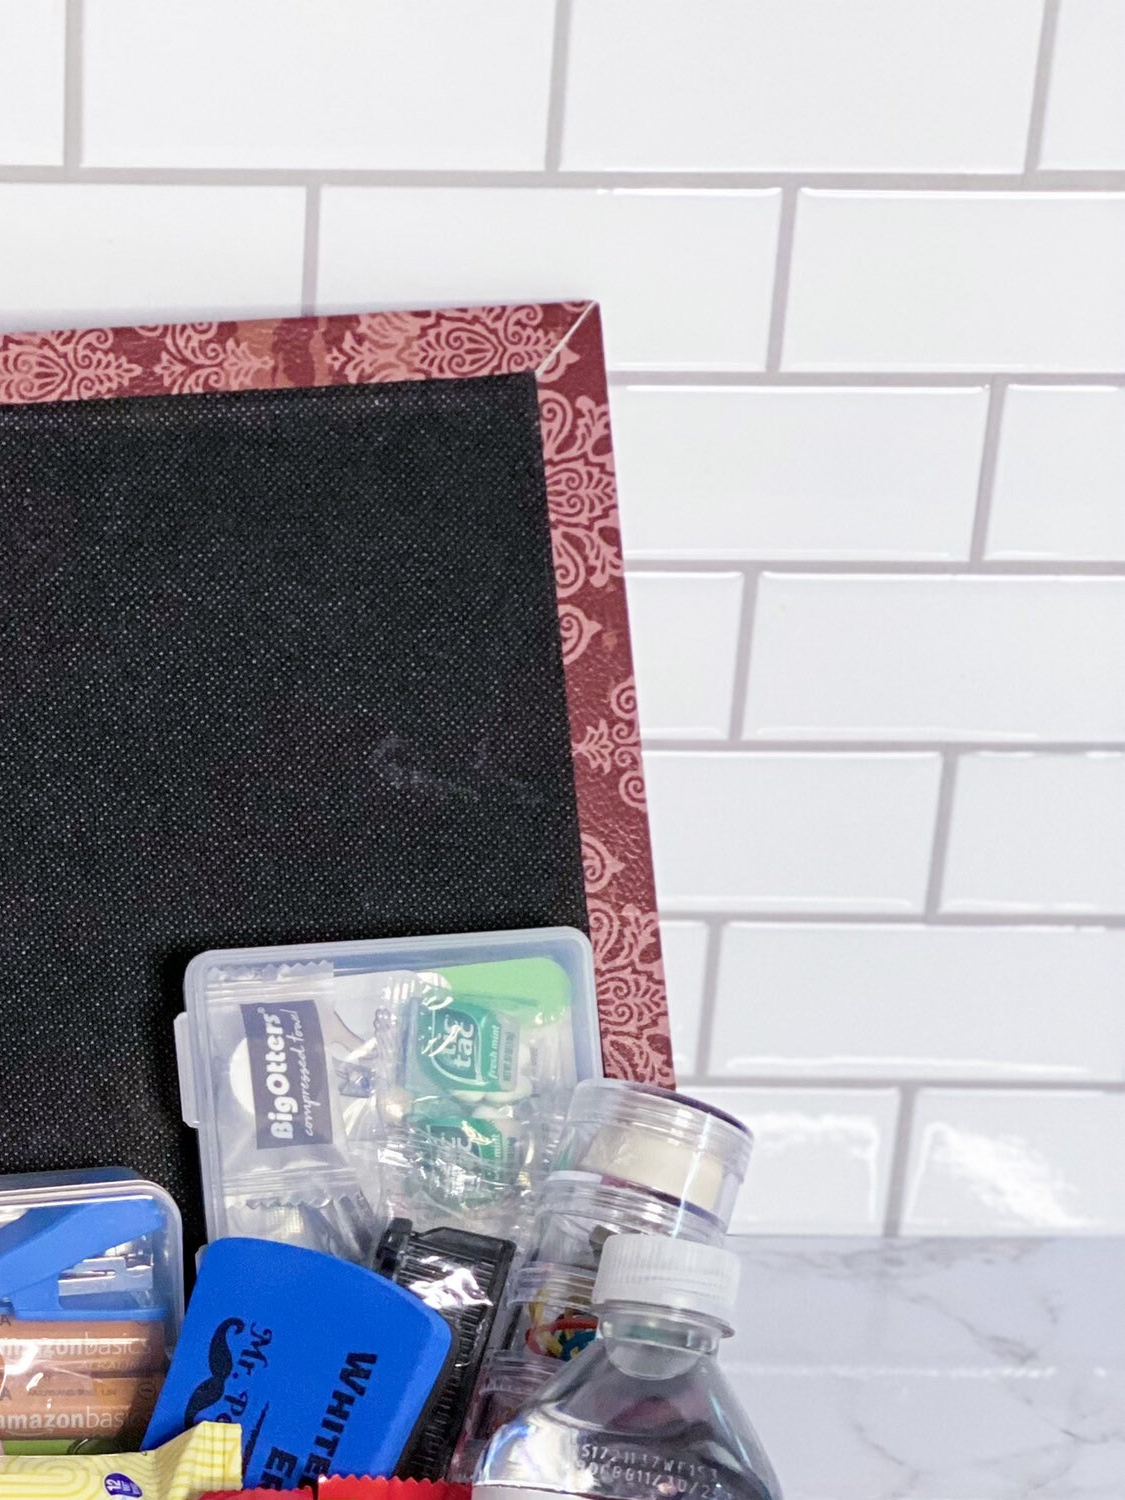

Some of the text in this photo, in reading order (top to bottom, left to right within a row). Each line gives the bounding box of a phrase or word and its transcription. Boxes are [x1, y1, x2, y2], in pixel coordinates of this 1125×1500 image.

[452, 1020, 474, 1067] tac
[265, 1011, 299, 1139] BigOtters
[233, 1322, 272, 1381] Mr.
[106, 1478, 121, 1491] 12
